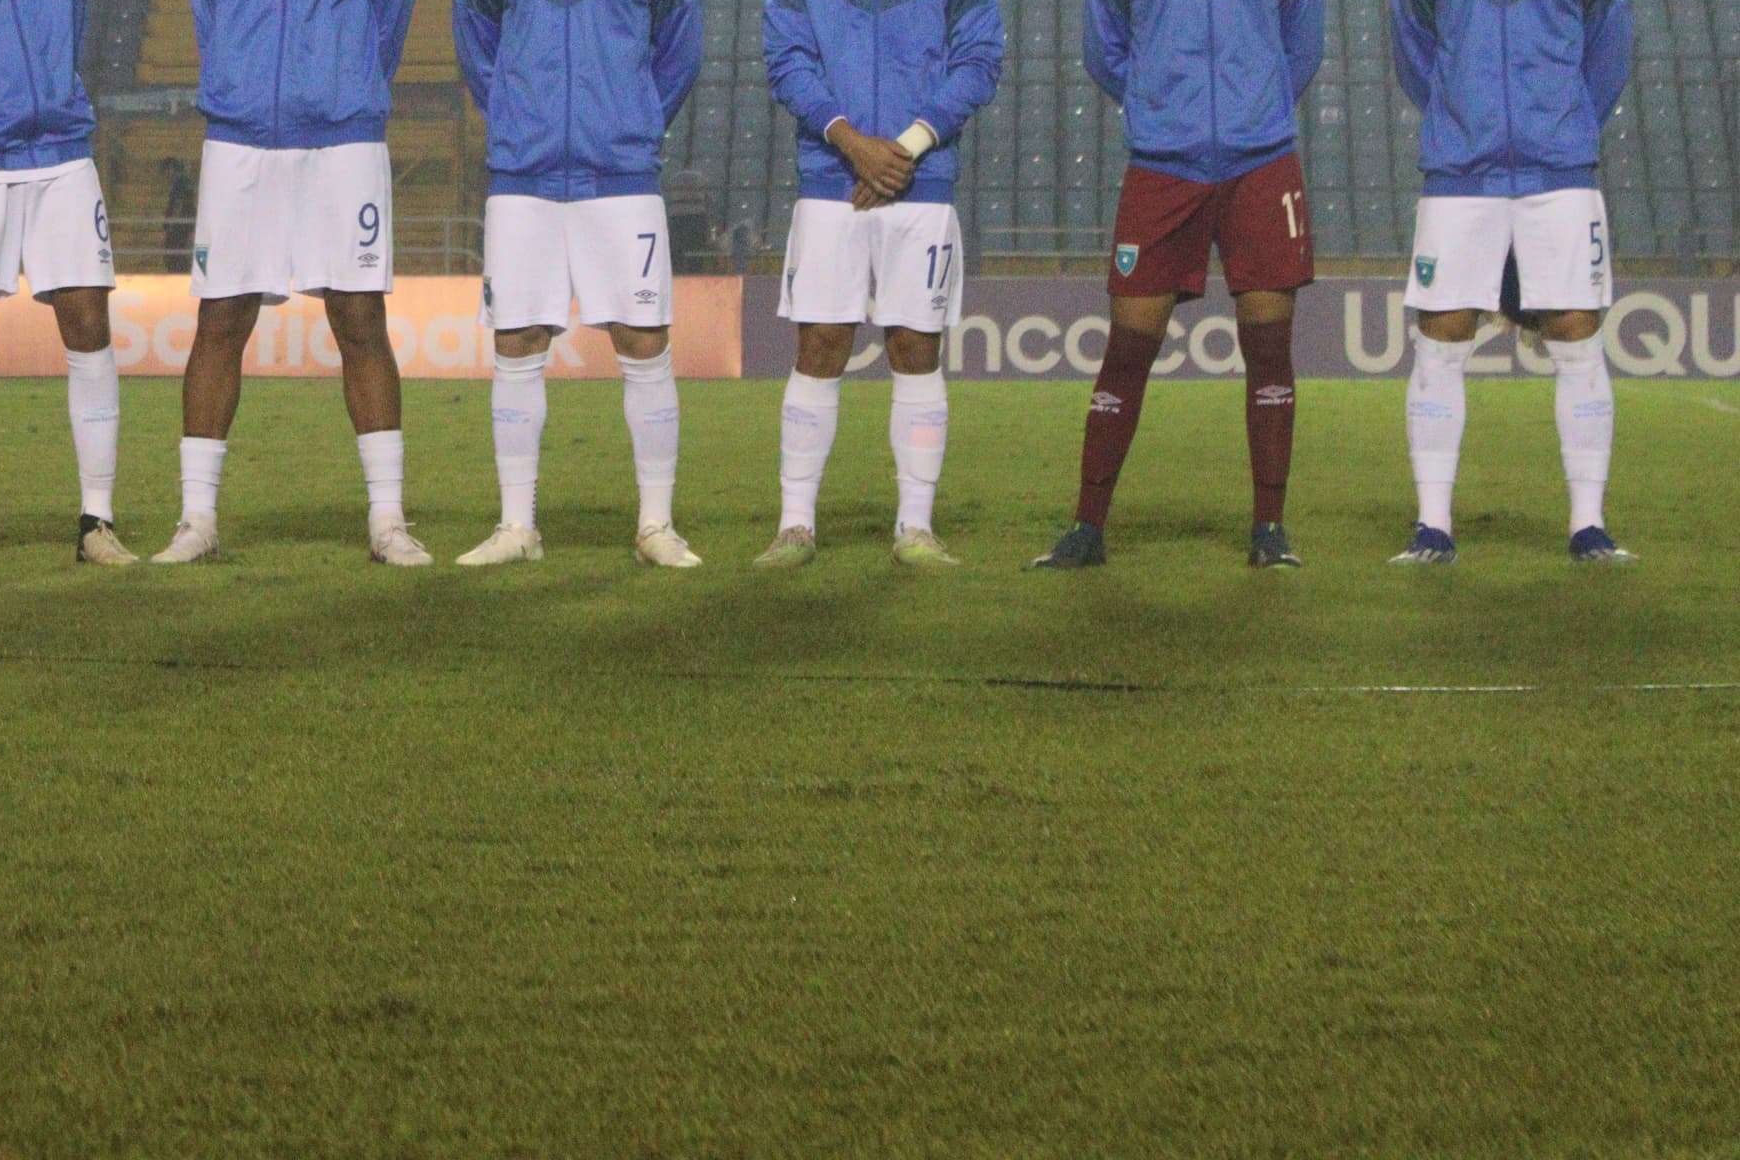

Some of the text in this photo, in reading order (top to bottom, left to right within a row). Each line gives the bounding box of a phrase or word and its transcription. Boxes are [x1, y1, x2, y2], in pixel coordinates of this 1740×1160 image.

[358, 202, 379, 247] 9
[1589, 221, 1604, 265] 5
[637, 232, 656, 278] 7
[925, 243, 953, 290] 17
